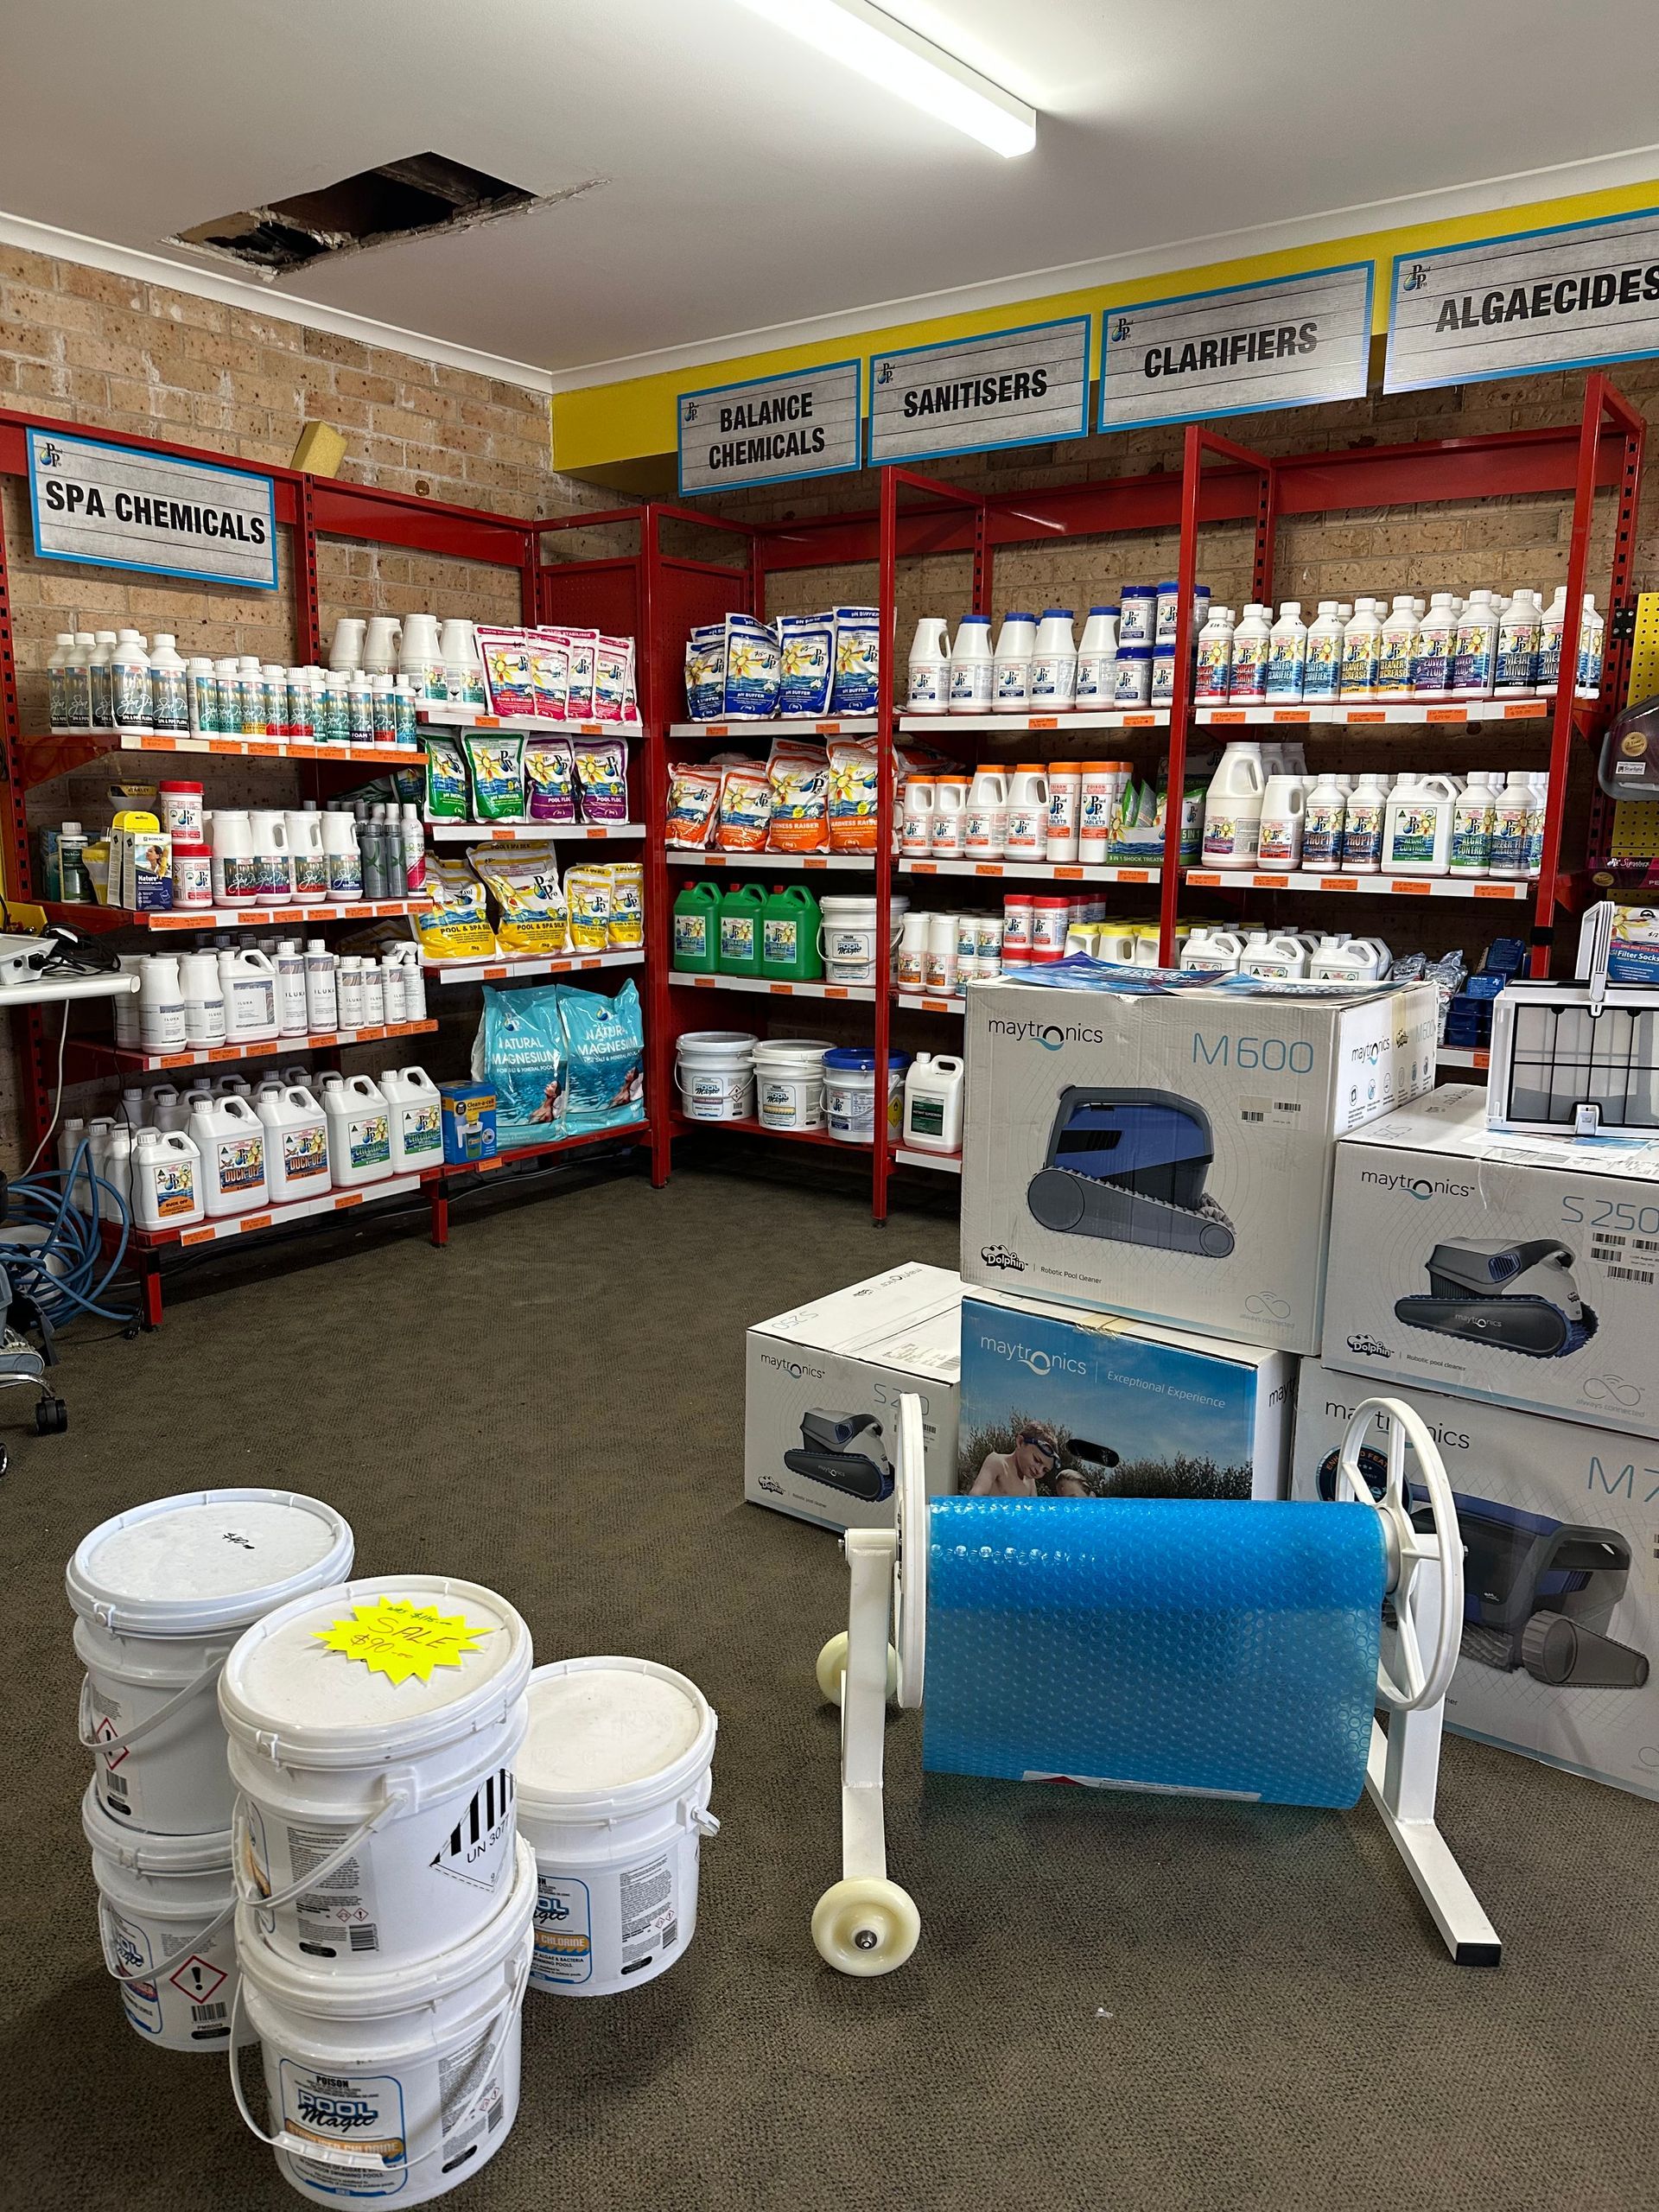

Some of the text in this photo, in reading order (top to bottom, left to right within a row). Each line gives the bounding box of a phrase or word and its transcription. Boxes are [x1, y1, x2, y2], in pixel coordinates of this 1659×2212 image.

[1435, 264, 1659, 333] ALGAECIDES
[1144, 322, 1318, 378] CLARIFIERS
[903, 368, 1048, 418] SANITISERS
[720, 391, 813, 433] BALANCE
[709, 426, 825, 470] CHEMICALS
[46, 480, 266, 544] SPA CHEMICALS
[1504, 654, 1530, 664] METAL
[1503, 664, 1530, 676] MINUS
[1182, 830, 1186, 839] 5
[1187, 830, 1195, 839] IN
[1461, 836, 1483, 845] ALGAE
[1457, 845, 1485, 855] CONTROL
[1620, 858, 1650, 868] Signature
[1617, 950, 1659, 962] Filter Socks
[988, 1017, 1103, 1049] maytronics
[576, 1035, 639, 1056] MAGNESIUM
[1351, 1036, 1390, 1065] maytronics
[695, 1083, 720, 1091] POOL
[766, 1091, 788, 1100] POOL
[467, 1098, 495, 1108] Clean-a-cell
[1361, 1169, 1469, 1198] maytronics
[987, 1253, 1026, 1272] Dolphin
[1040, 1266, 1063, 1276] Robotic
[1078, 1274, 1103, 1285] Cleaner
[1454, 1313, 1503, 1328] maytronics
[1352, 1342, 1391, 1359] Dolphin
[760, 1353, 823, 1379] maytronics
[980, 1333, 1086, 1374] maytronics
[1107, 1370, 1165, 1394] Exceptional
[1166, 1385, 1226, 1410] Experience
[1407, 1354, 1467, 1372] Robotic pool cleaner
[1575, 1398, 1645, 1418] always connected
[367, 1617, 460, 1649] SALE
[467, 1844, 486, 1864] UN
[541, 1934, 586, 1948] CHLORINE
[539, 1951, 555, 1960] ALGAE
[560, 1955, 584, 1963] BACTERIA
[316, 2075, 349, 2088] POISON
[297, 2088, 378, 2119] POOL
[299, 2105, 375, 2133] Magic
